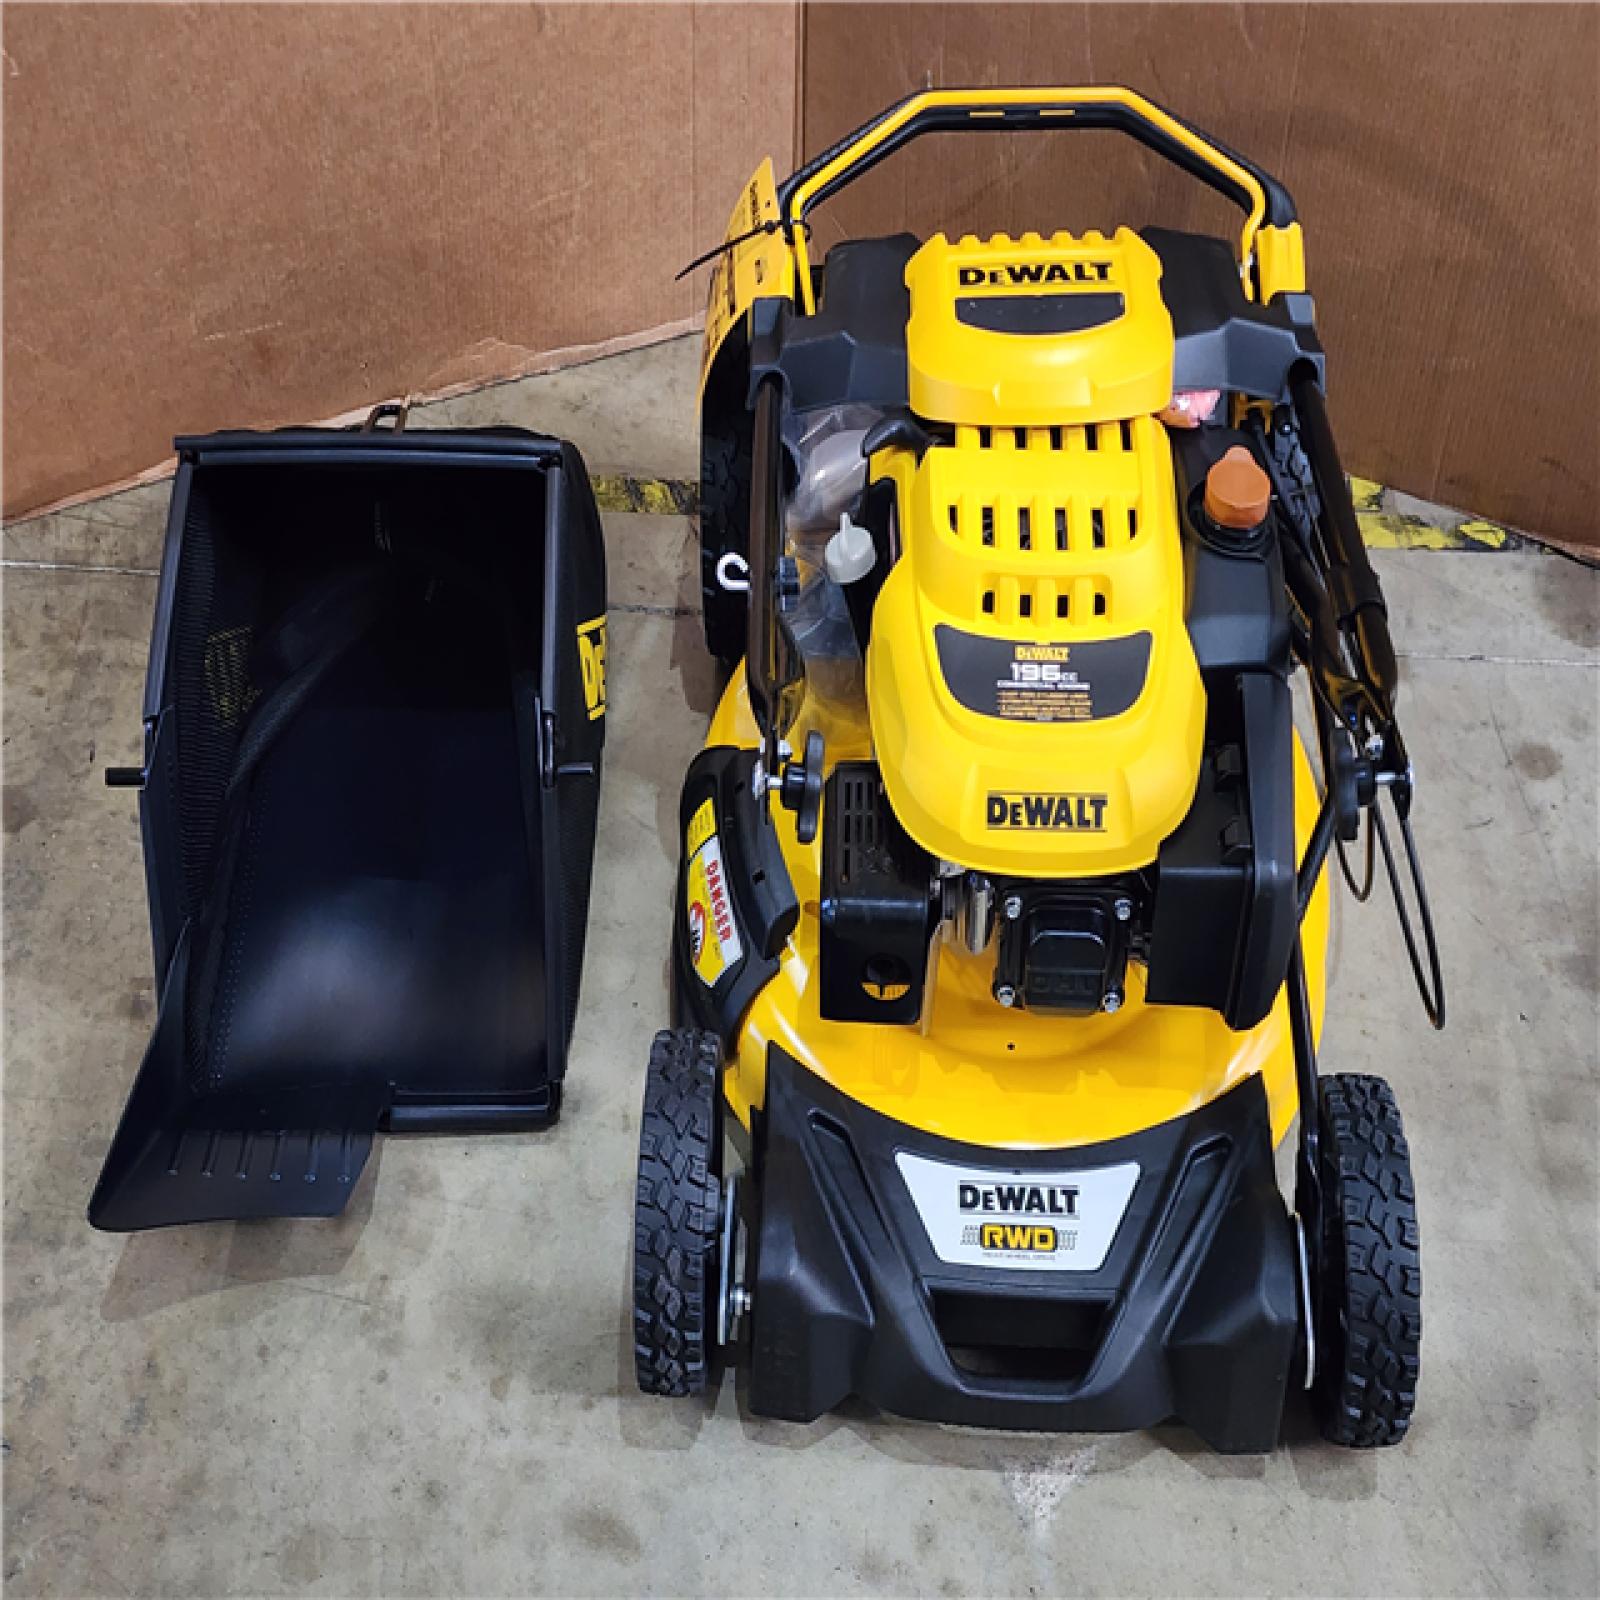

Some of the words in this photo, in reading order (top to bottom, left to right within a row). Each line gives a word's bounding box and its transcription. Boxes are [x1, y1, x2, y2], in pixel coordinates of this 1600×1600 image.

[959, 262, 1112, 286] DEWALT
[986, 796, 1108, 829] DEWALT
[705, 859, 732, 943] DANGER
[959, 1184, 1079, 1214] DEWALT
[983, 1224, 1055, 1251] RWD
